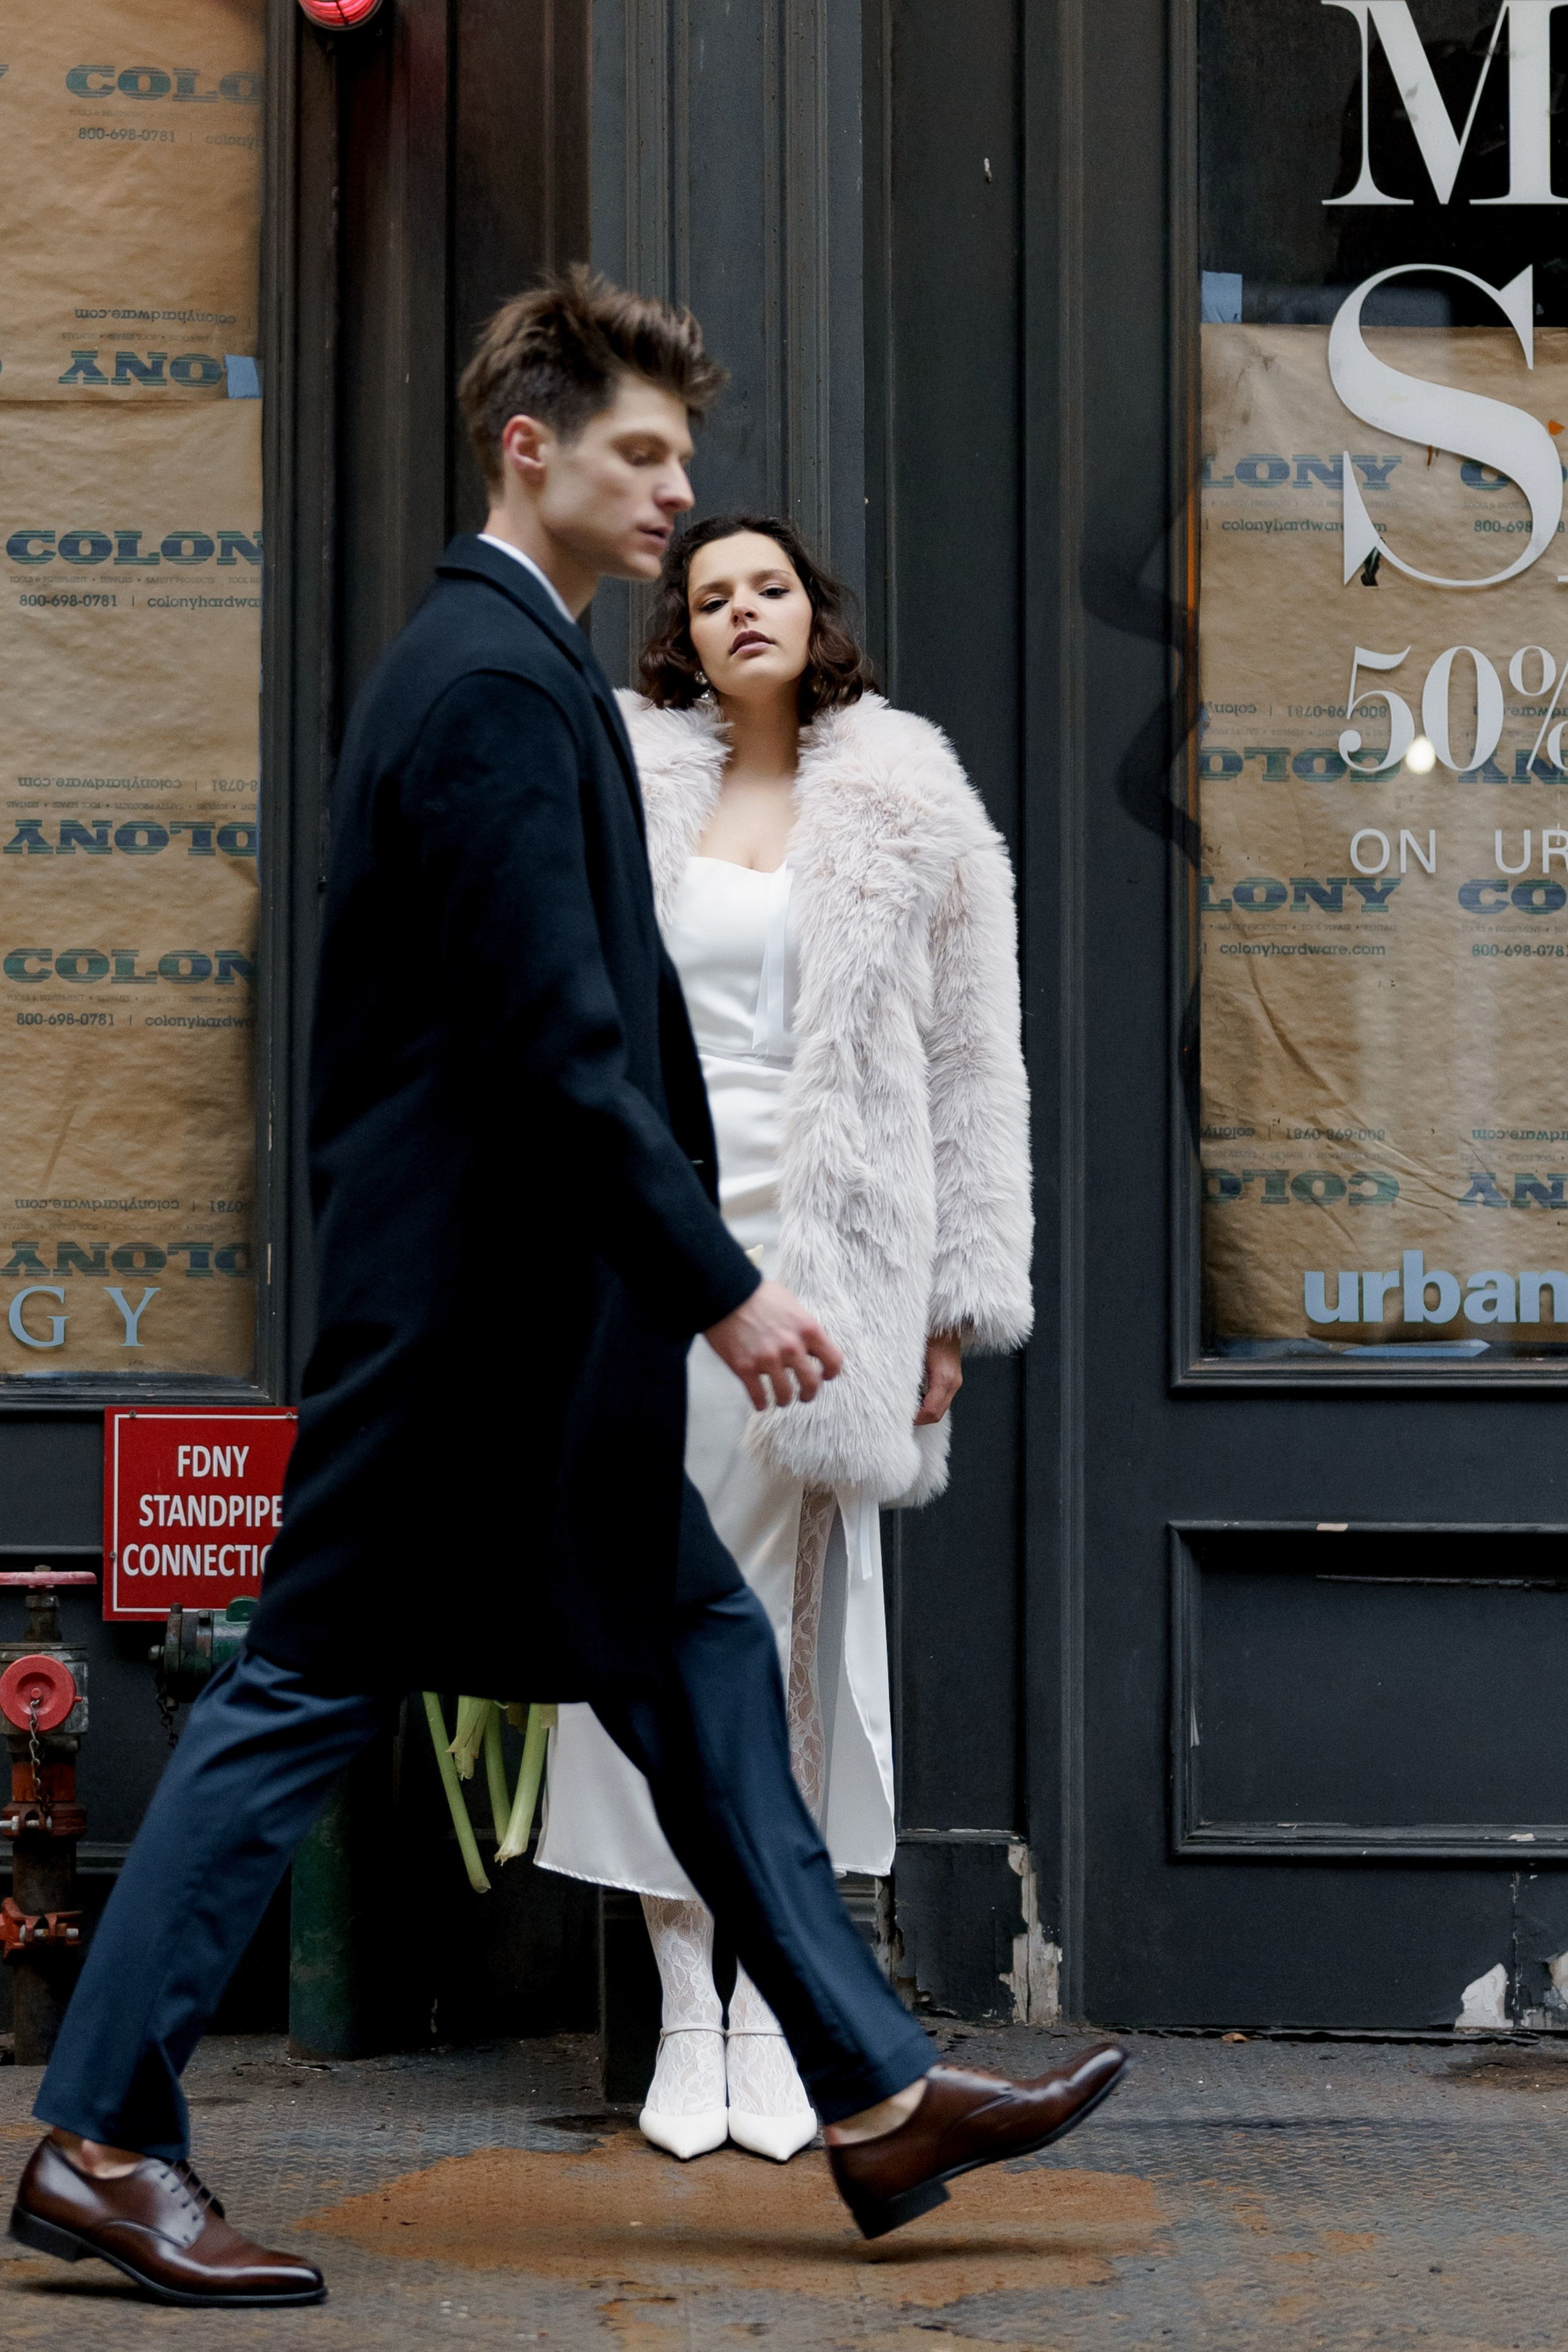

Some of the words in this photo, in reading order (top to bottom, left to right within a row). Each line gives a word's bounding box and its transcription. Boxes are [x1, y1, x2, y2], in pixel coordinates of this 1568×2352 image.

[78, 127, 176, 143] 800-698-0781
[20, 594, 117, 607] 800-698-0781
[18, 776, 183, 791] colonyhardware.com
[1349, 828, 1436, 874] ON
[1219, 943, 1386, 957] colonyhardware.com
[16, 1012, 115, 1026] 800-698-0781
[15, 1198, 179, 1213] colonyhardware.com
[1304, 1250, 1568, 1324] urban
[178, 1446, 249, 1477] FDNY
[138, 1494, 283, 1527] STANDPIPE
